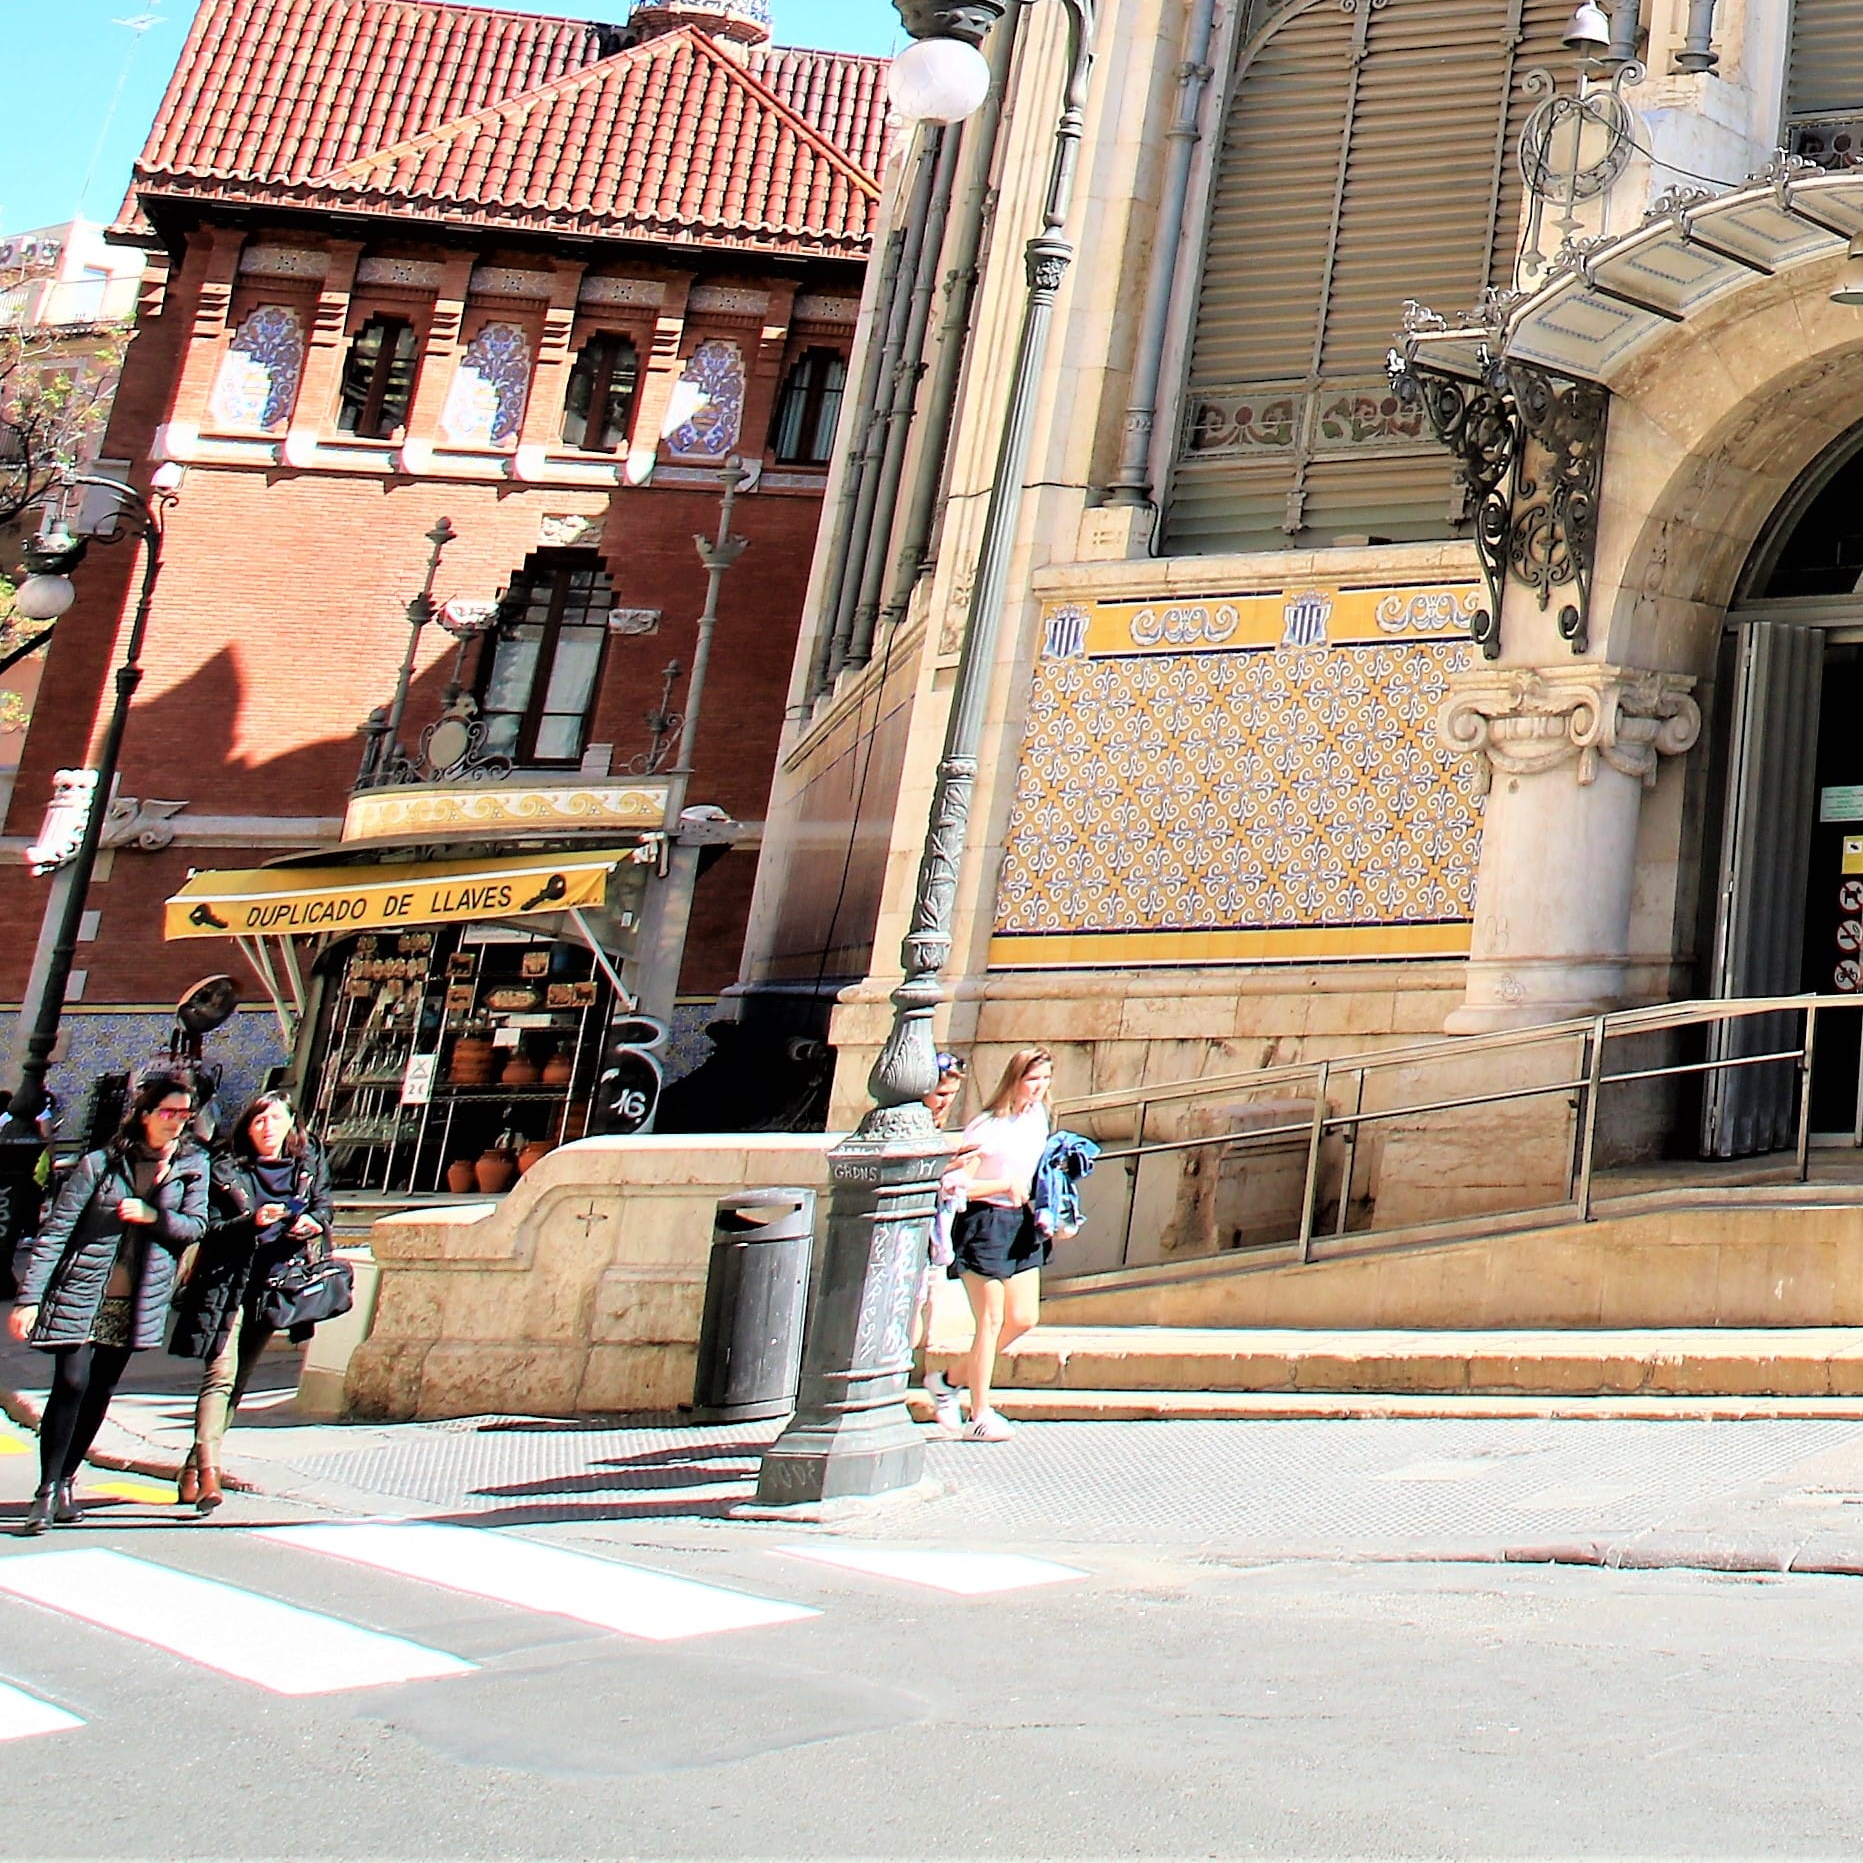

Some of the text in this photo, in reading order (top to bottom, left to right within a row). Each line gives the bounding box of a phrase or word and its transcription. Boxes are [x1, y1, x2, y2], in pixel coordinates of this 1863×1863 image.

[246, 885, 512, 927] DUPLICADO DE LLAVES
